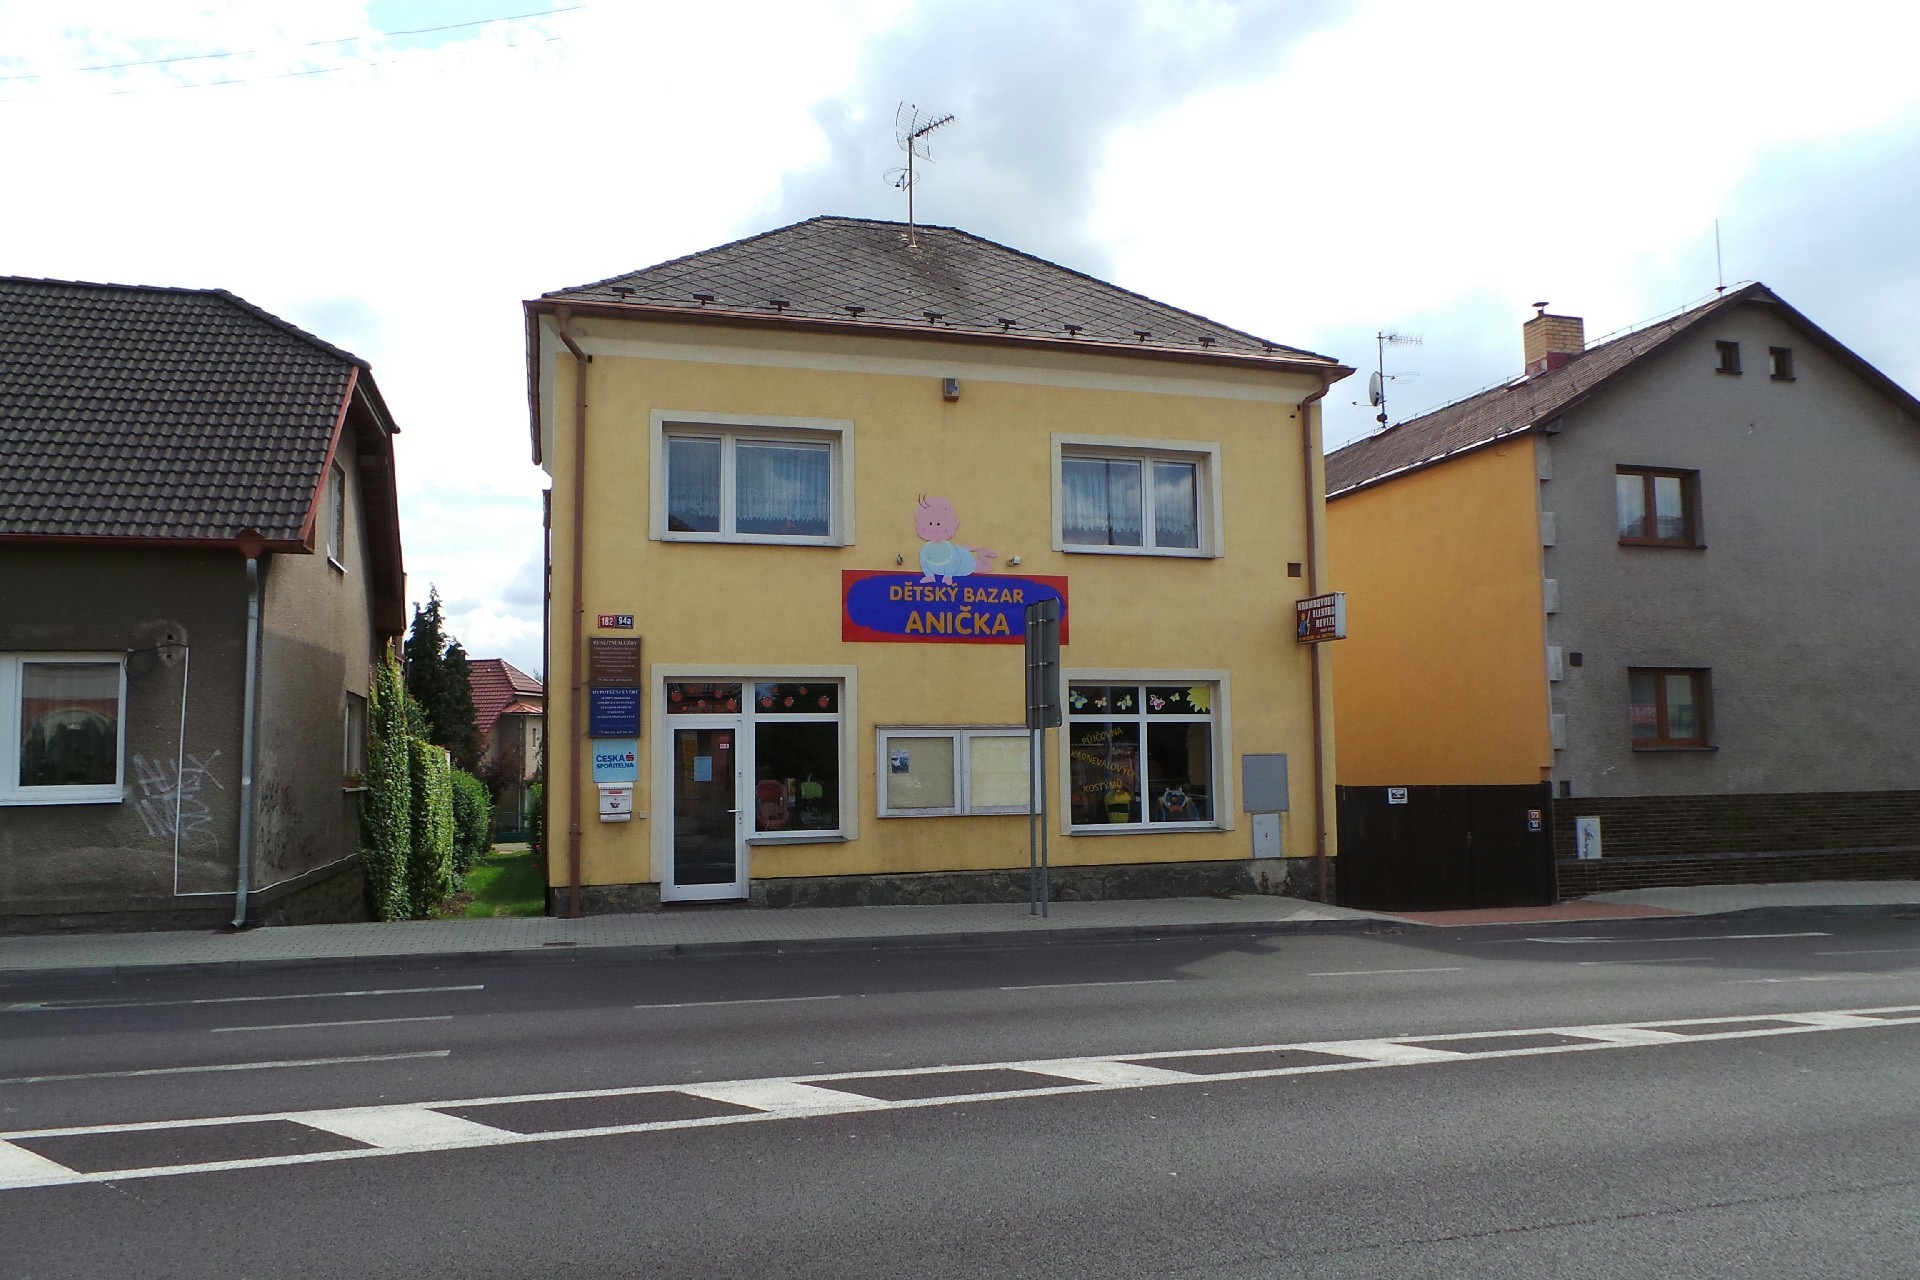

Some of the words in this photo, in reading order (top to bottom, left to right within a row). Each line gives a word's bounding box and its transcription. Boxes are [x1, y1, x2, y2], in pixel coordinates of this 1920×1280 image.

[889, 581, 958, 602] DĚTSKÝ
[963, 587, 1024, 604] BAZAR
[1313, 606, 1334, 617] ELEKTRO
[600, 616, 614, 626] 182
[618, 616, 632, 625] 94a
[904, 605, 1010, 635] ANIČKA
[1316, 617, 1334, 627] REVIZE
[1081, 727, 1124, 745] PŮJČOVNA
[596, 753, 626, 763] ČESKÁ
[1083, 778, 1123, 793] KOSTÝMŮ
